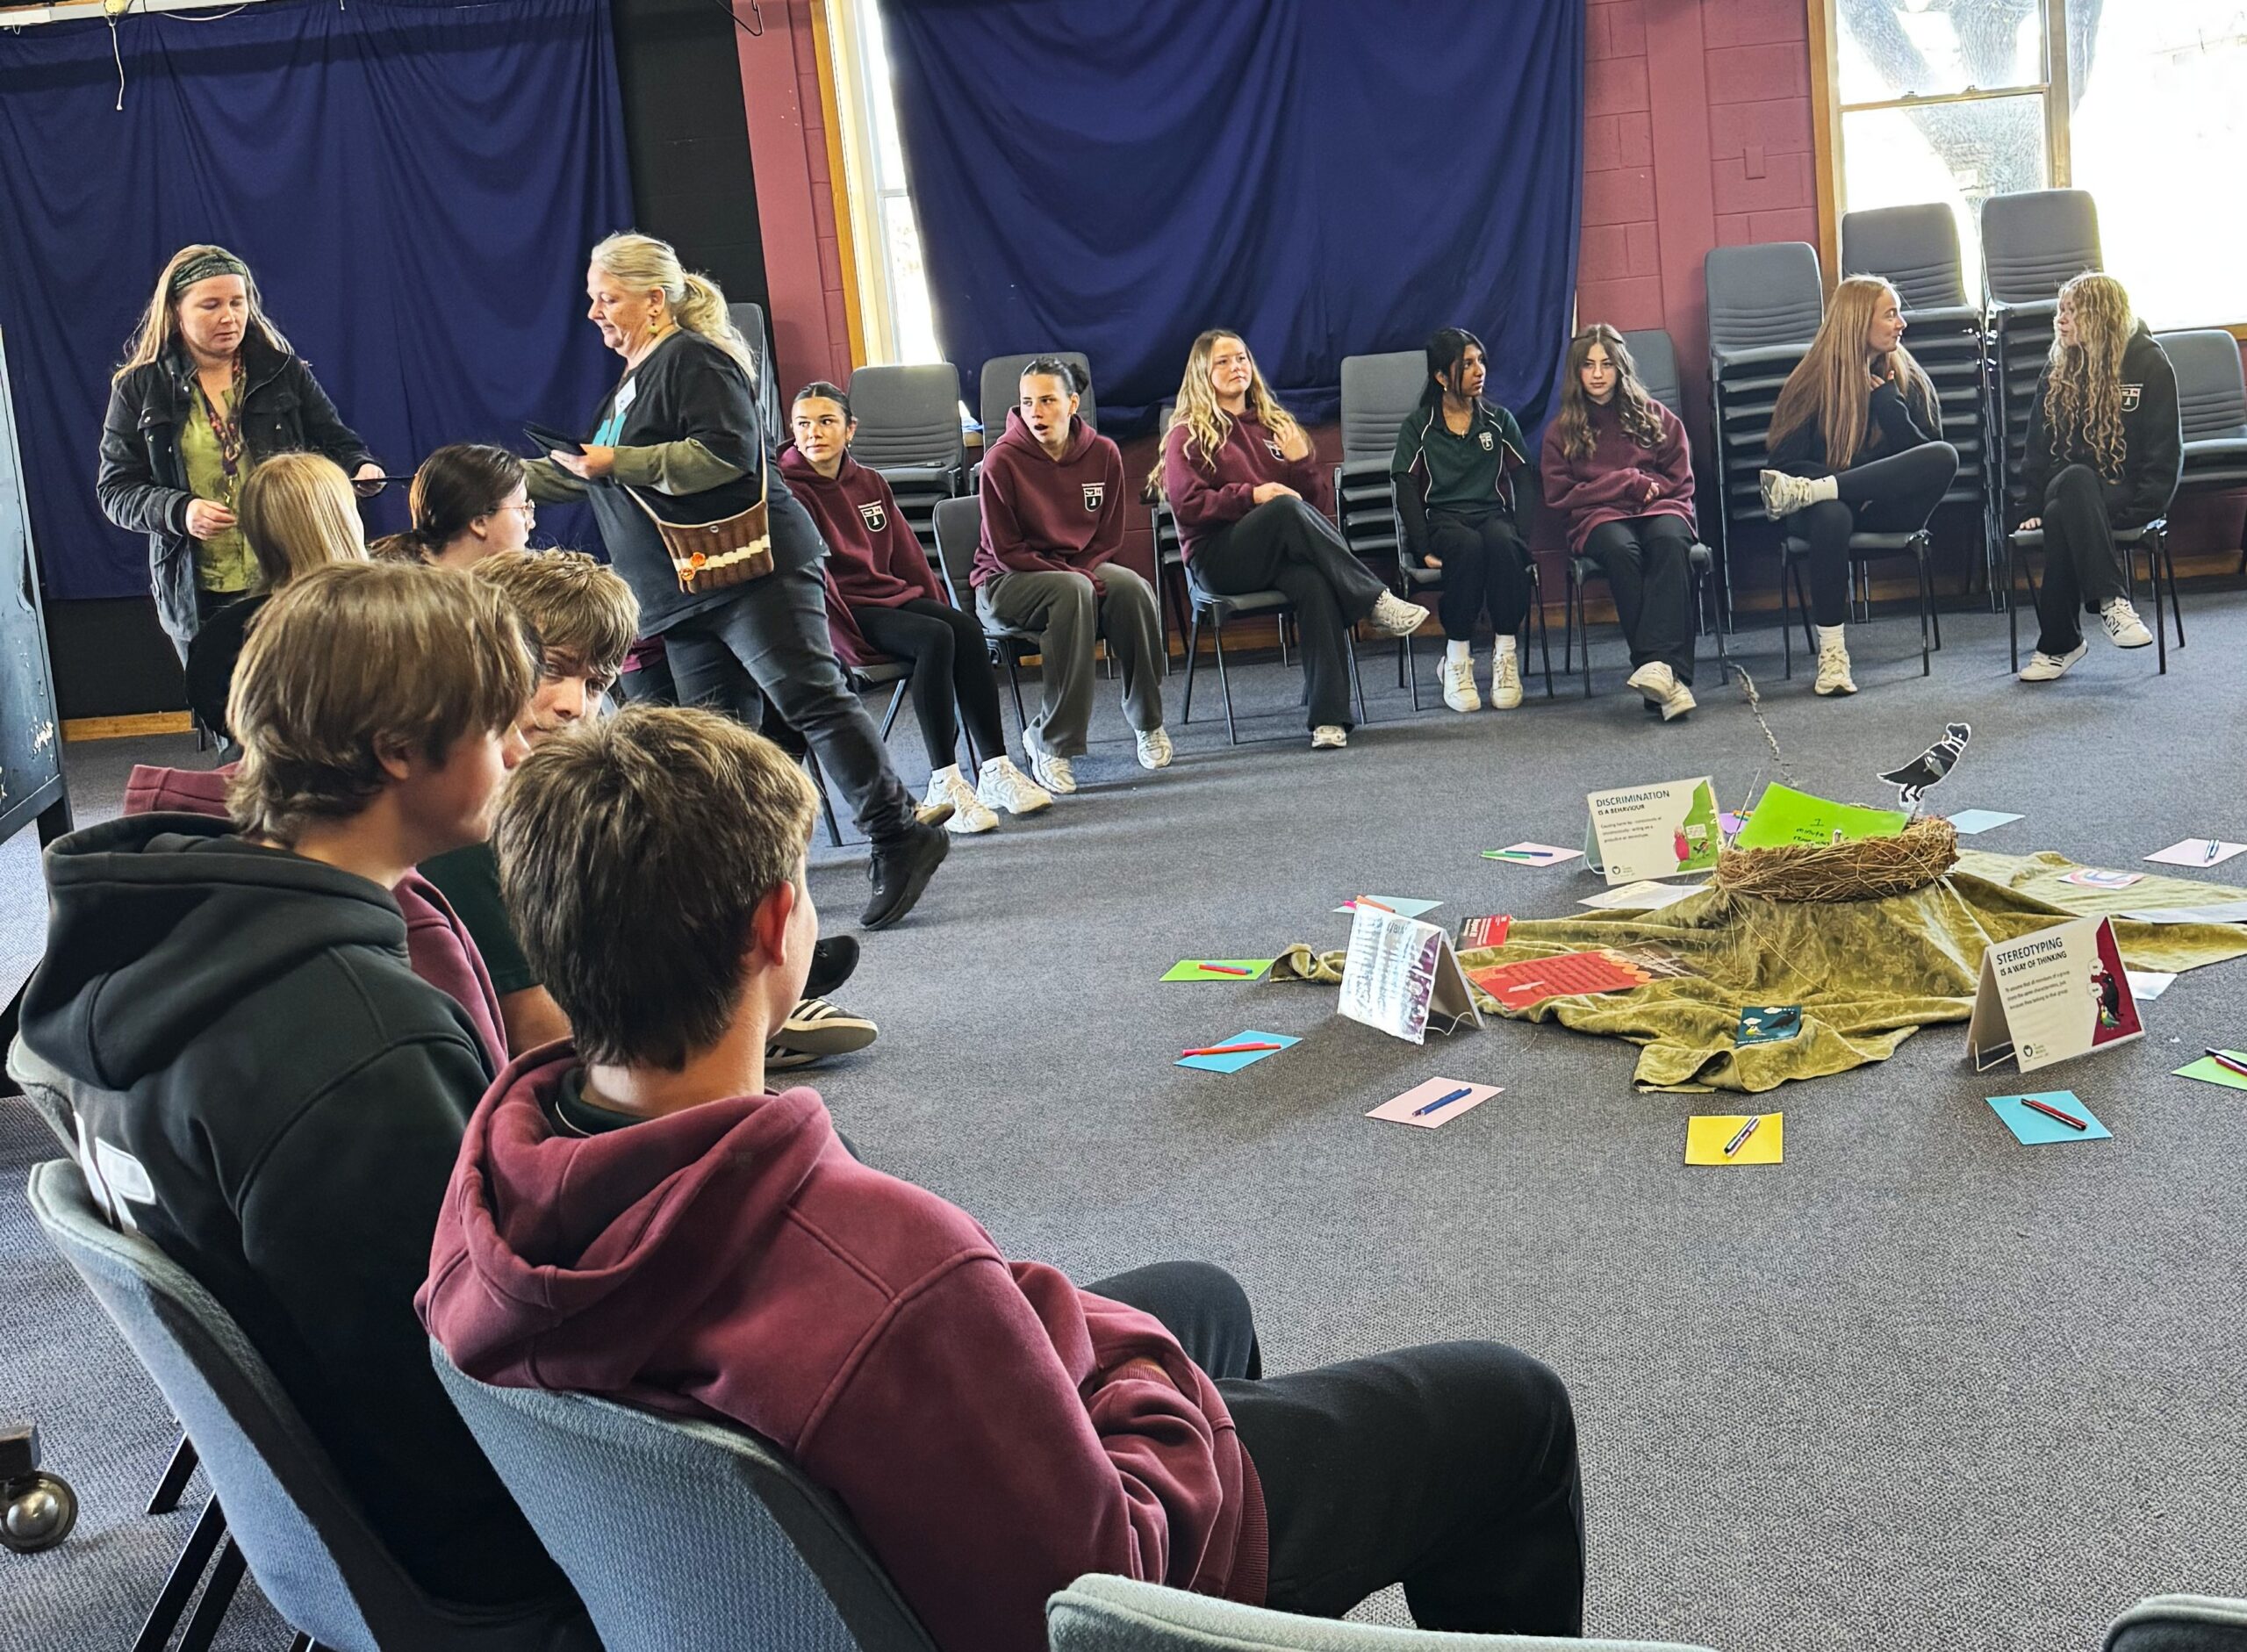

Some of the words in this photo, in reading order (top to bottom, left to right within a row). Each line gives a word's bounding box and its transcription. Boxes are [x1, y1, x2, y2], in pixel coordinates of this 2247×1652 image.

[1596, 790, 1670, 808] DISCRIMINATION
[1611, 804, 1645, 814] BEHAVIOUR
[1996, 937, 2064, 965] STEREOTYPING
[1999, 967, 2007, 976] IS
[2007, 966, 2013, 974] A
[2012, 962, 2027, 973] WAY
[2027, 959, 2035, 968] OF
[2036, 950, 2067, 966] THINKING
